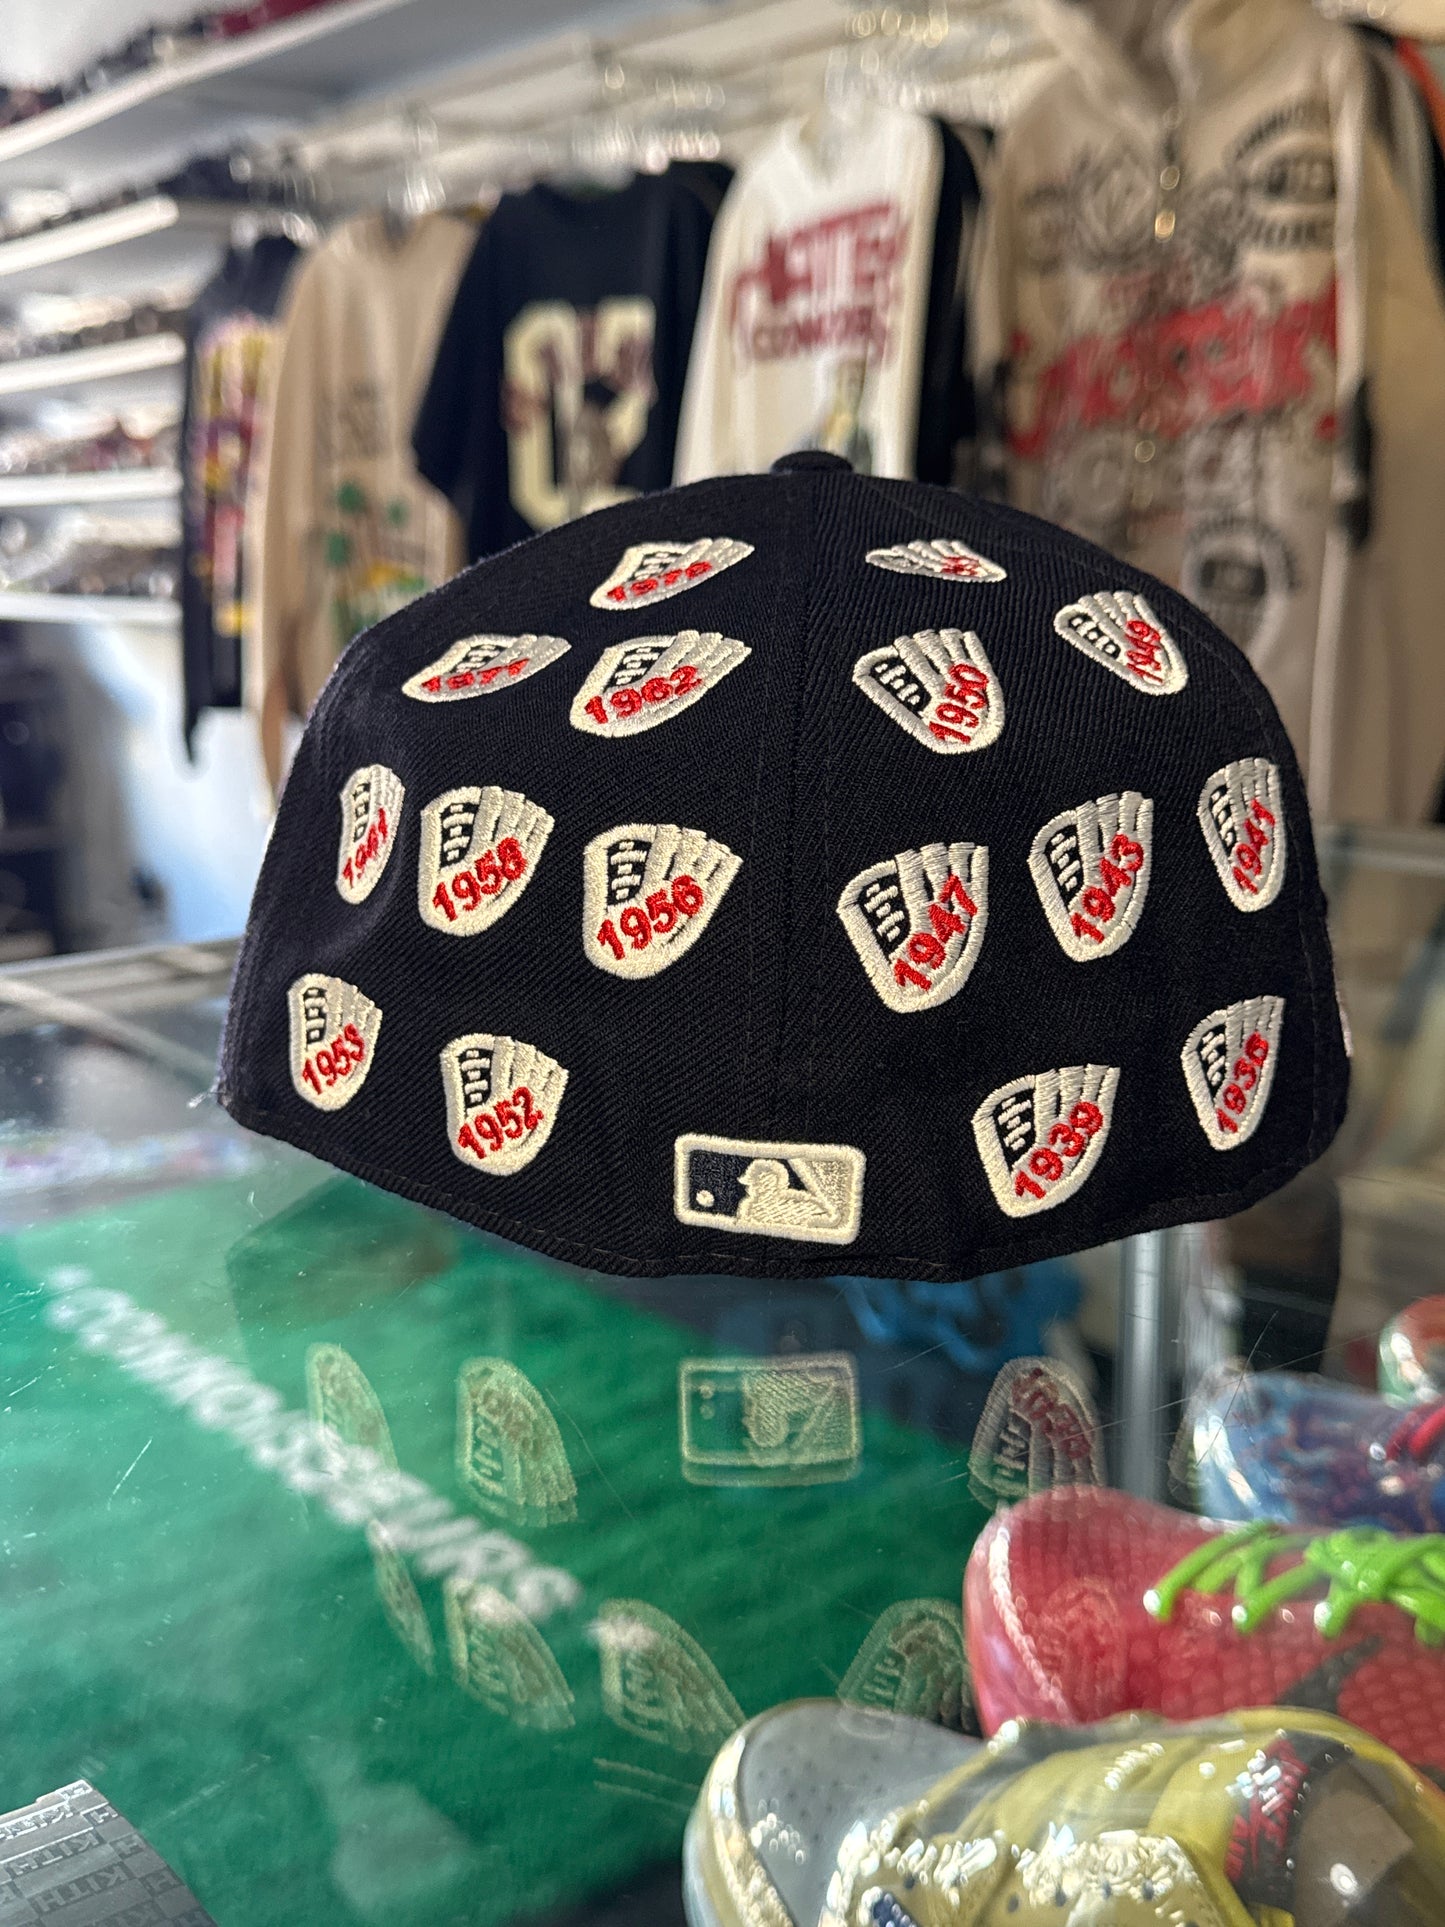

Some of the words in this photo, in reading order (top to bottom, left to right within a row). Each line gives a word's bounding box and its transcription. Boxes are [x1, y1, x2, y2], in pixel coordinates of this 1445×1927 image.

[584, 665, 703, 725] 1962
[928, 663, 991, 744] 1950
[432, 836, 528, 922] 1958
[1069, 833, 1145, 944] 1943
[1232, 798, 1276, 895] 1941
[596, 874, 705, 961] 1956
[893, 873, 979, 992] 1947
[301, 1023, 366, 1095] 1953
[1216, 1030, 1270, 1134] 1936
[457, 1086, 545, 1160] 1952
[1014, 1101, 1104, 1200] 1939
[9, 1831, 99, 1876] KITH
[36, 1864, 129, 1913] KITH
